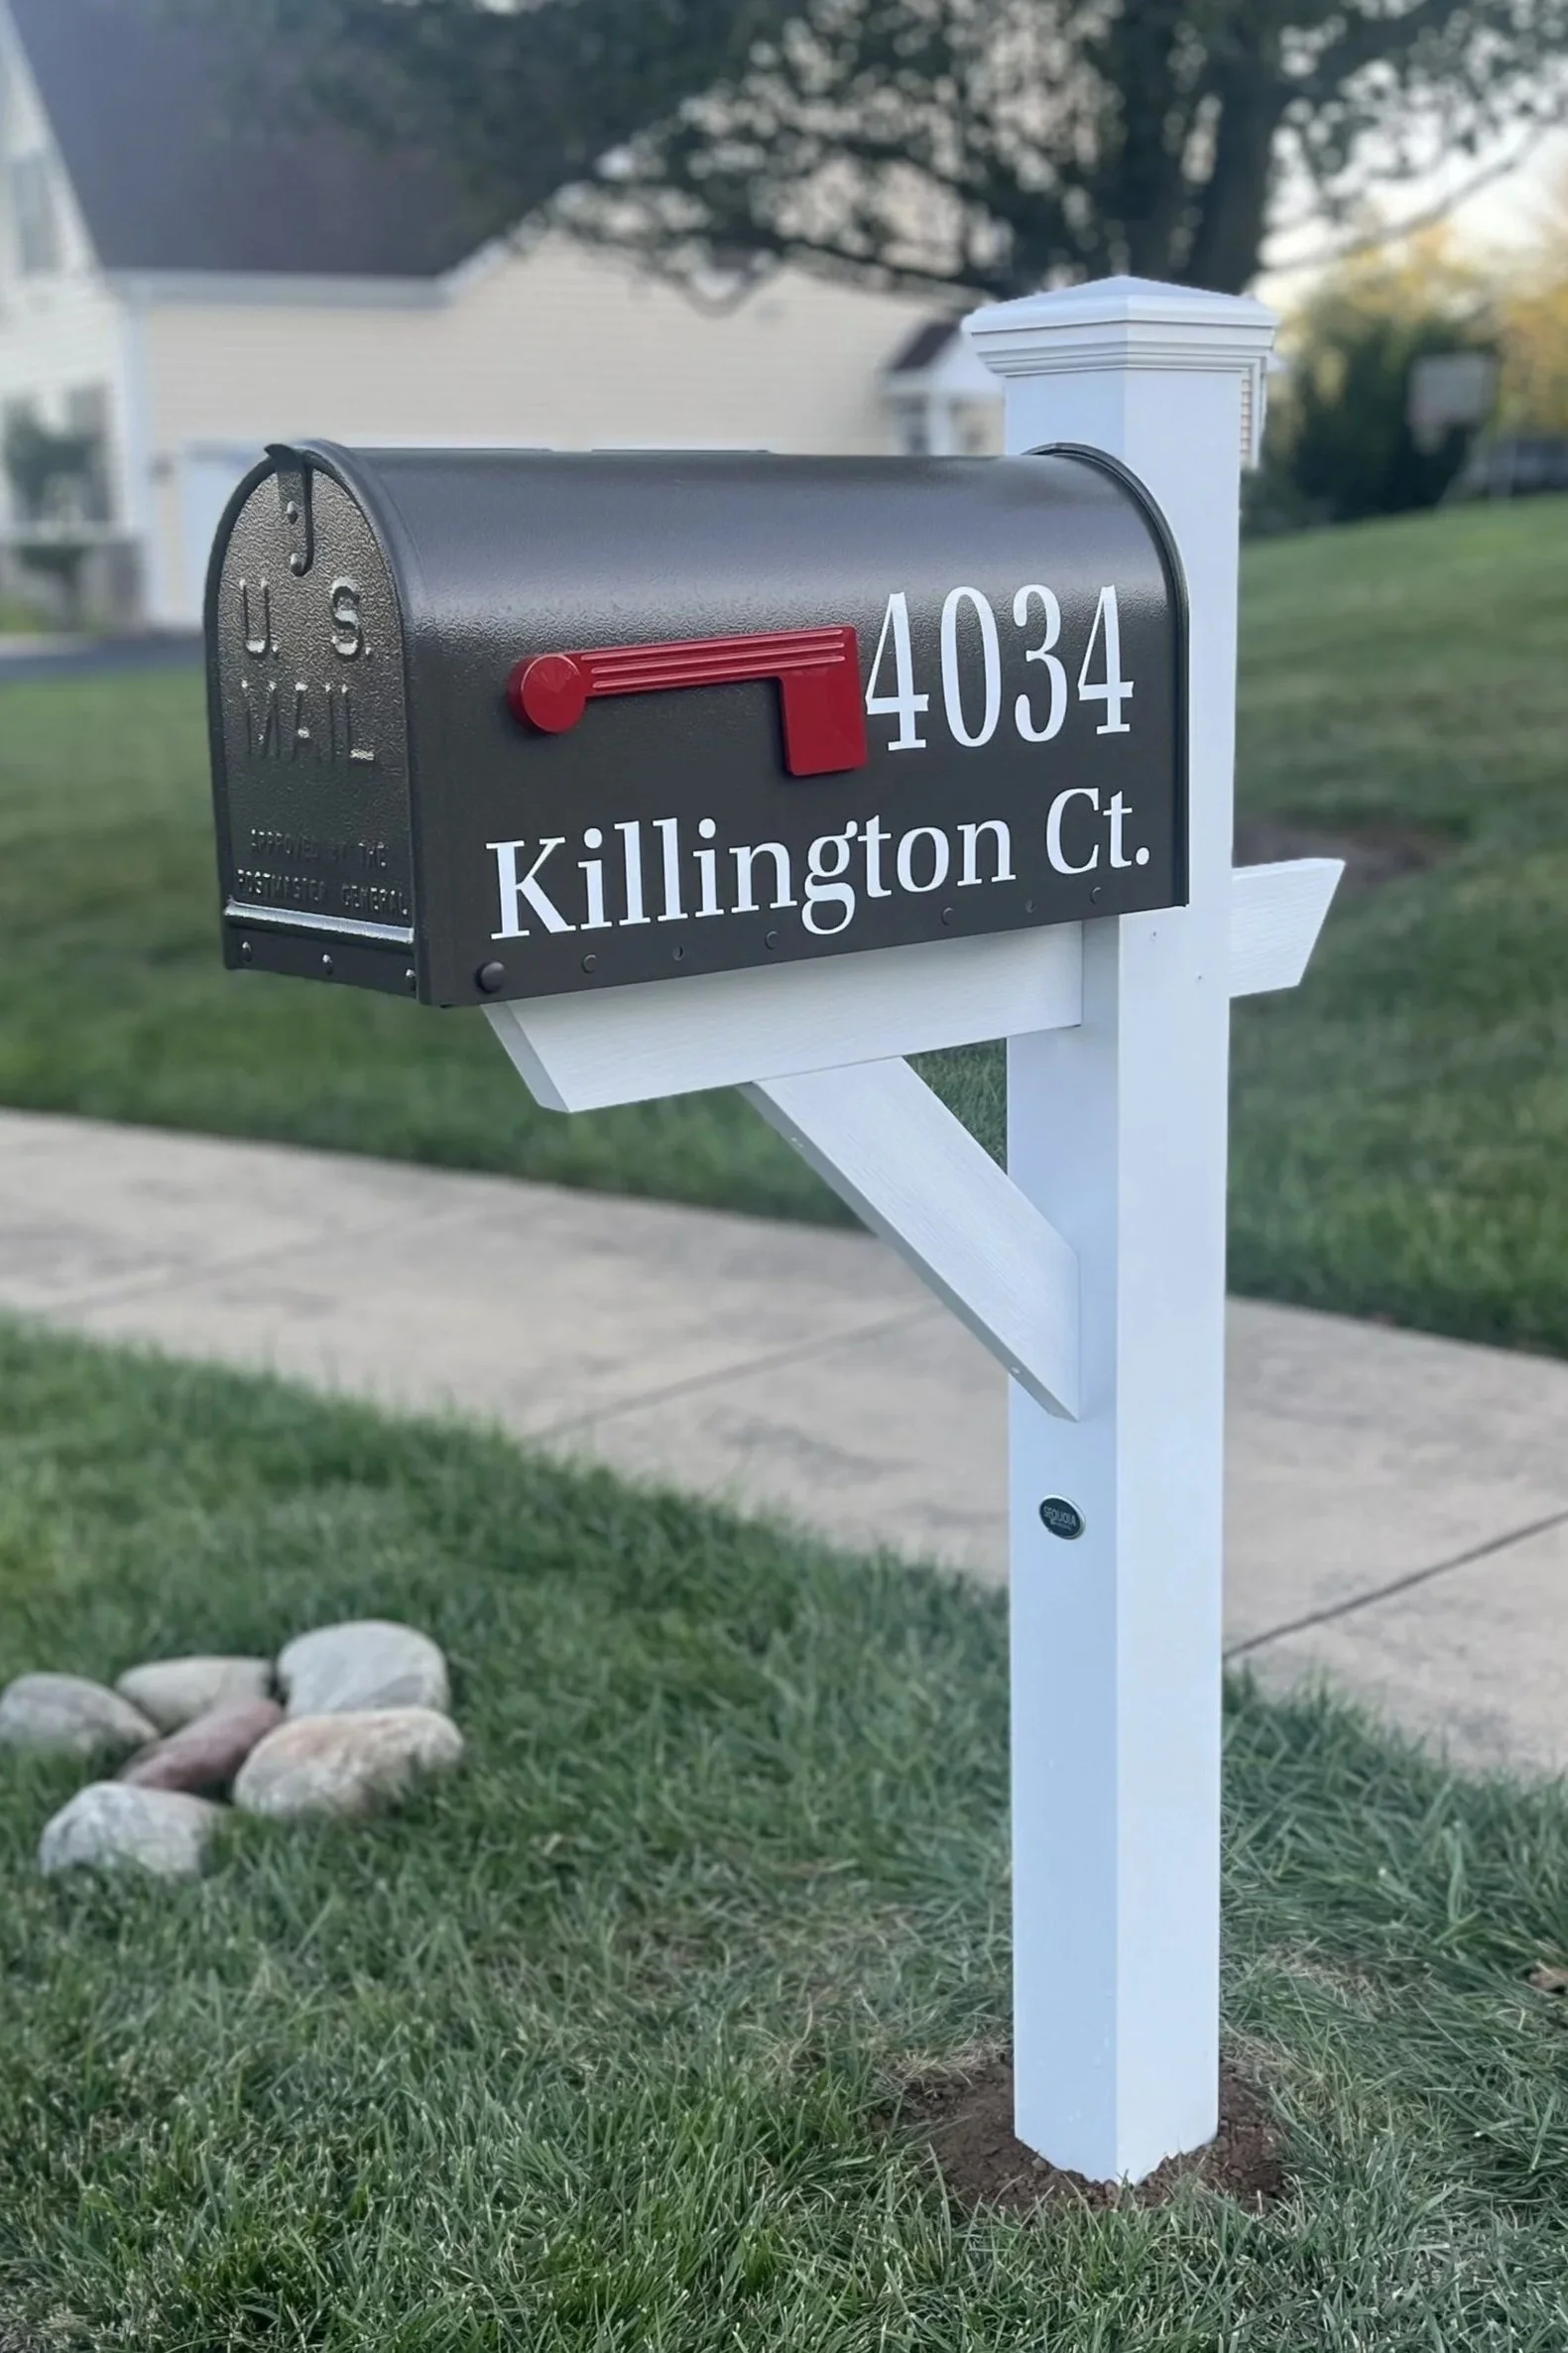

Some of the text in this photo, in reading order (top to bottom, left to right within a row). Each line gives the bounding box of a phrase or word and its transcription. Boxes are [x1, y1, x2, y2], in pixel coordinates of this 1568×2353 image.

[865, 584, 1134, 752] 4034
[486, 788, 1150, 939] Killington Ct.
